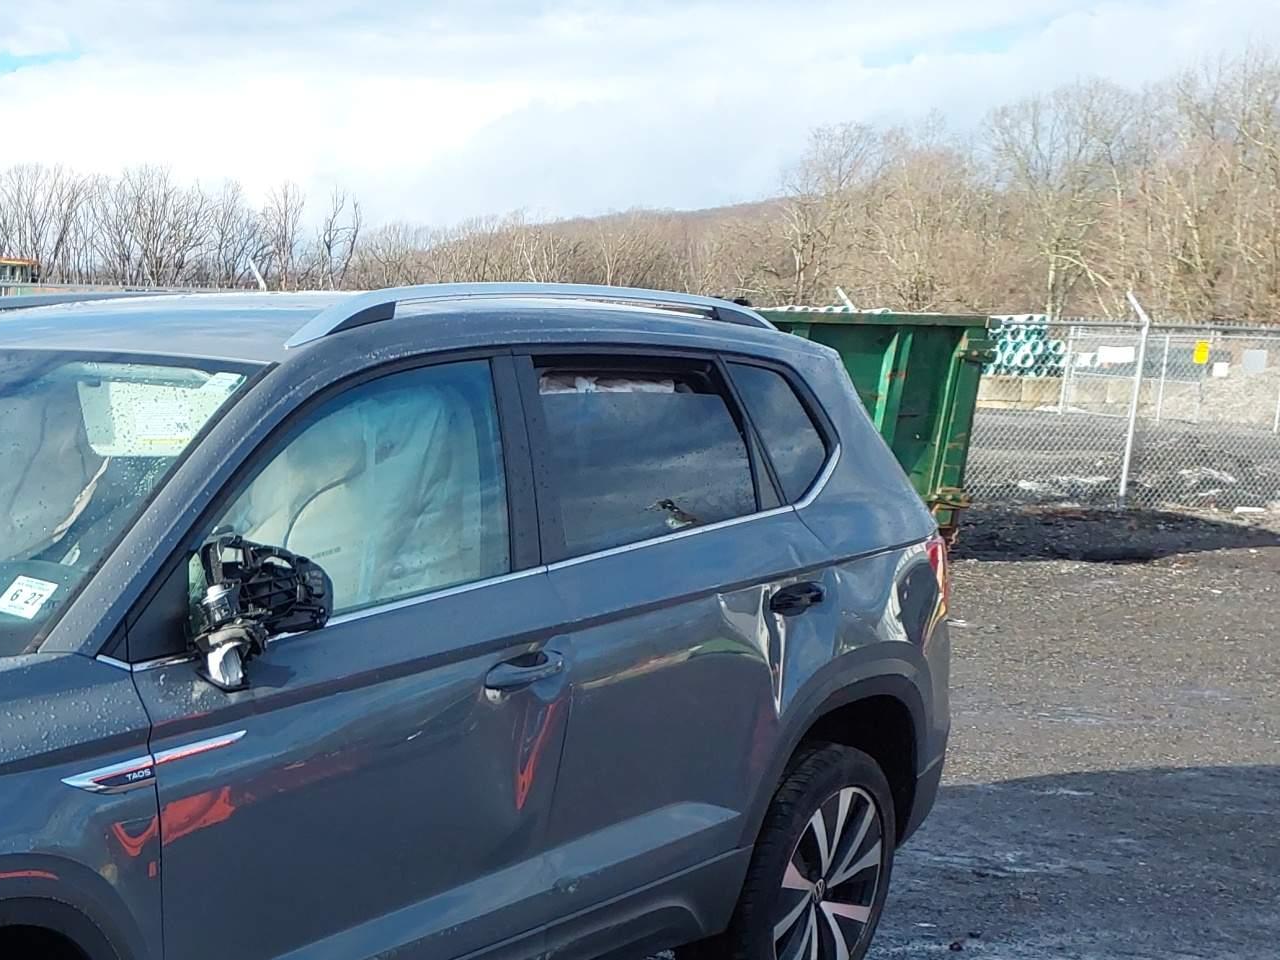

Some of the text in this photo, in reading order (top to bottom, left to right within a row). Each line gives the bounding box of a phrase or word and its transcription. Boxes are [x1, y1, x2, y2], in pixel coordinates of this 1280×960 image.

[10, 588, 23, 602] 6
[24, 592, 44, 606] 27
[126, 768, 152, 781] TAOS
